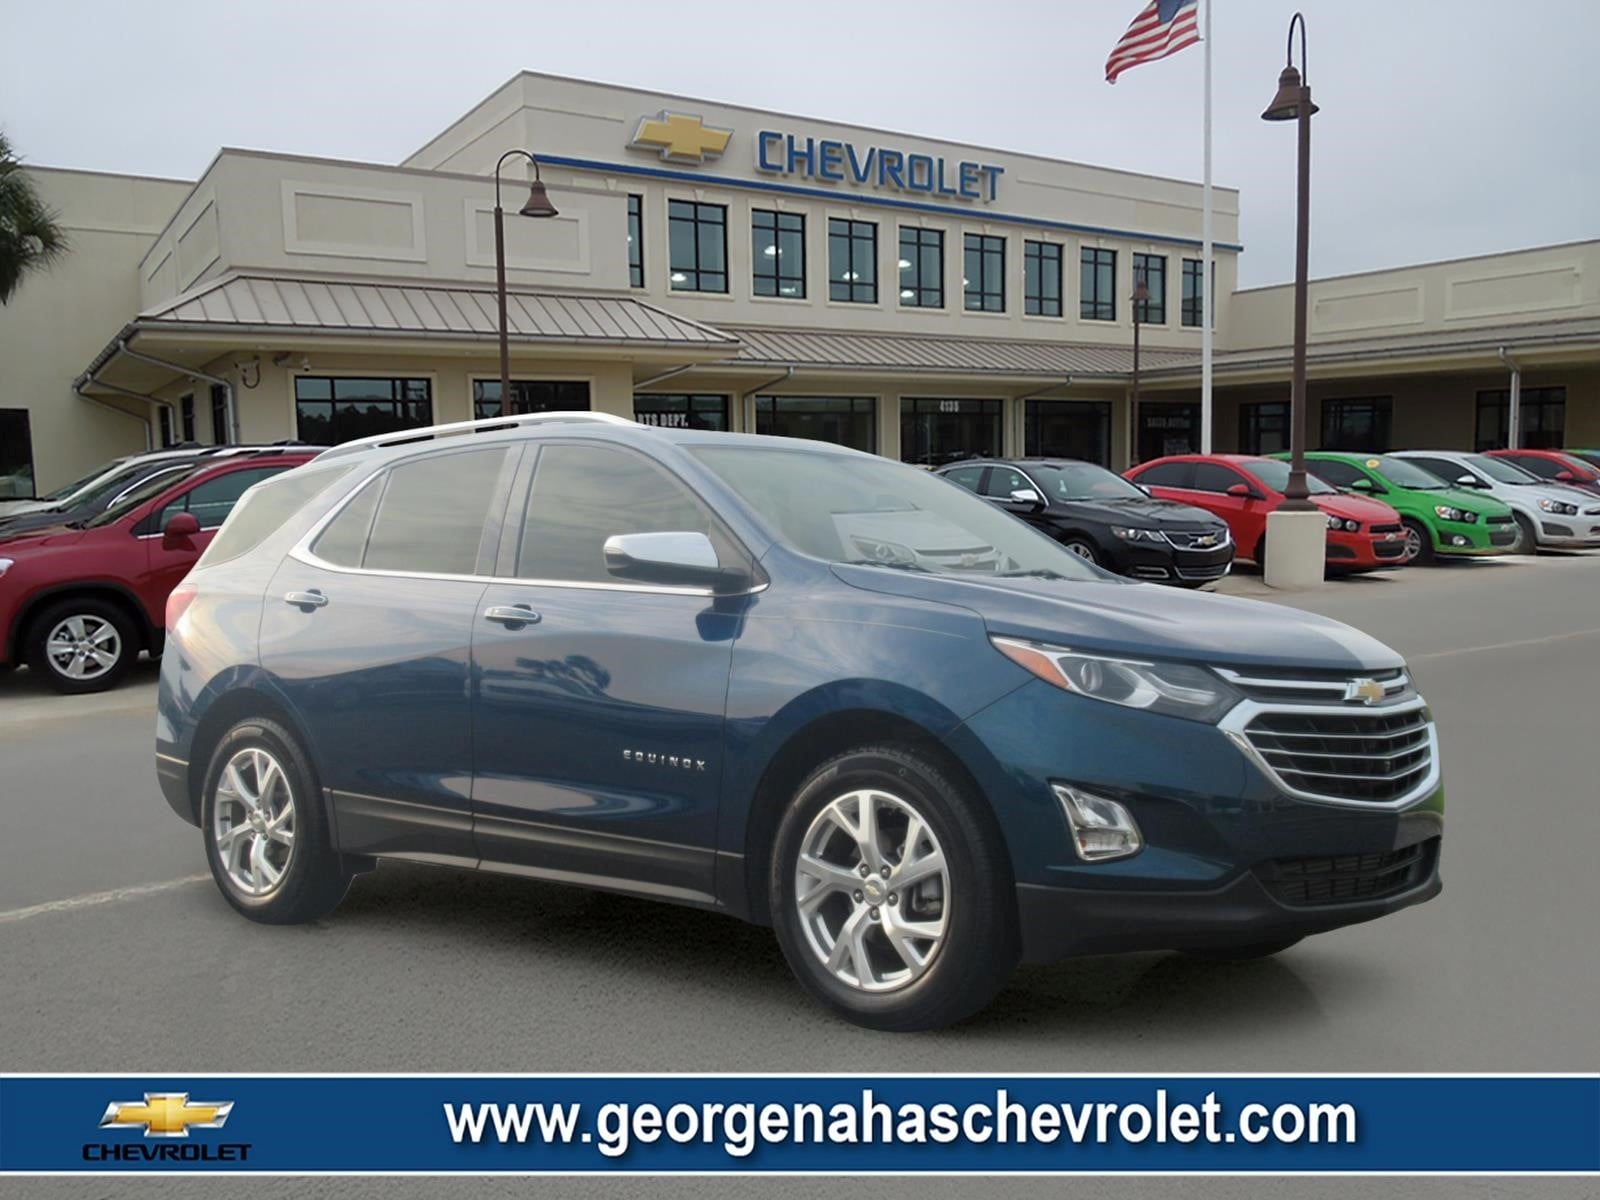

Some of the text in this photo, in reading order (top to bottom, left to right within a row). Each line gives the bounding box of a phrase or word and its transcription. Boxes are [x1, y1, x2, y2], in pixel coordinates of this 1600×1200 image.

[756, 129, 1005, 202] CHEVROLET
[660, 413, 689, 427] DEPT.
[623, 749, 706, 771] EQUINOX
